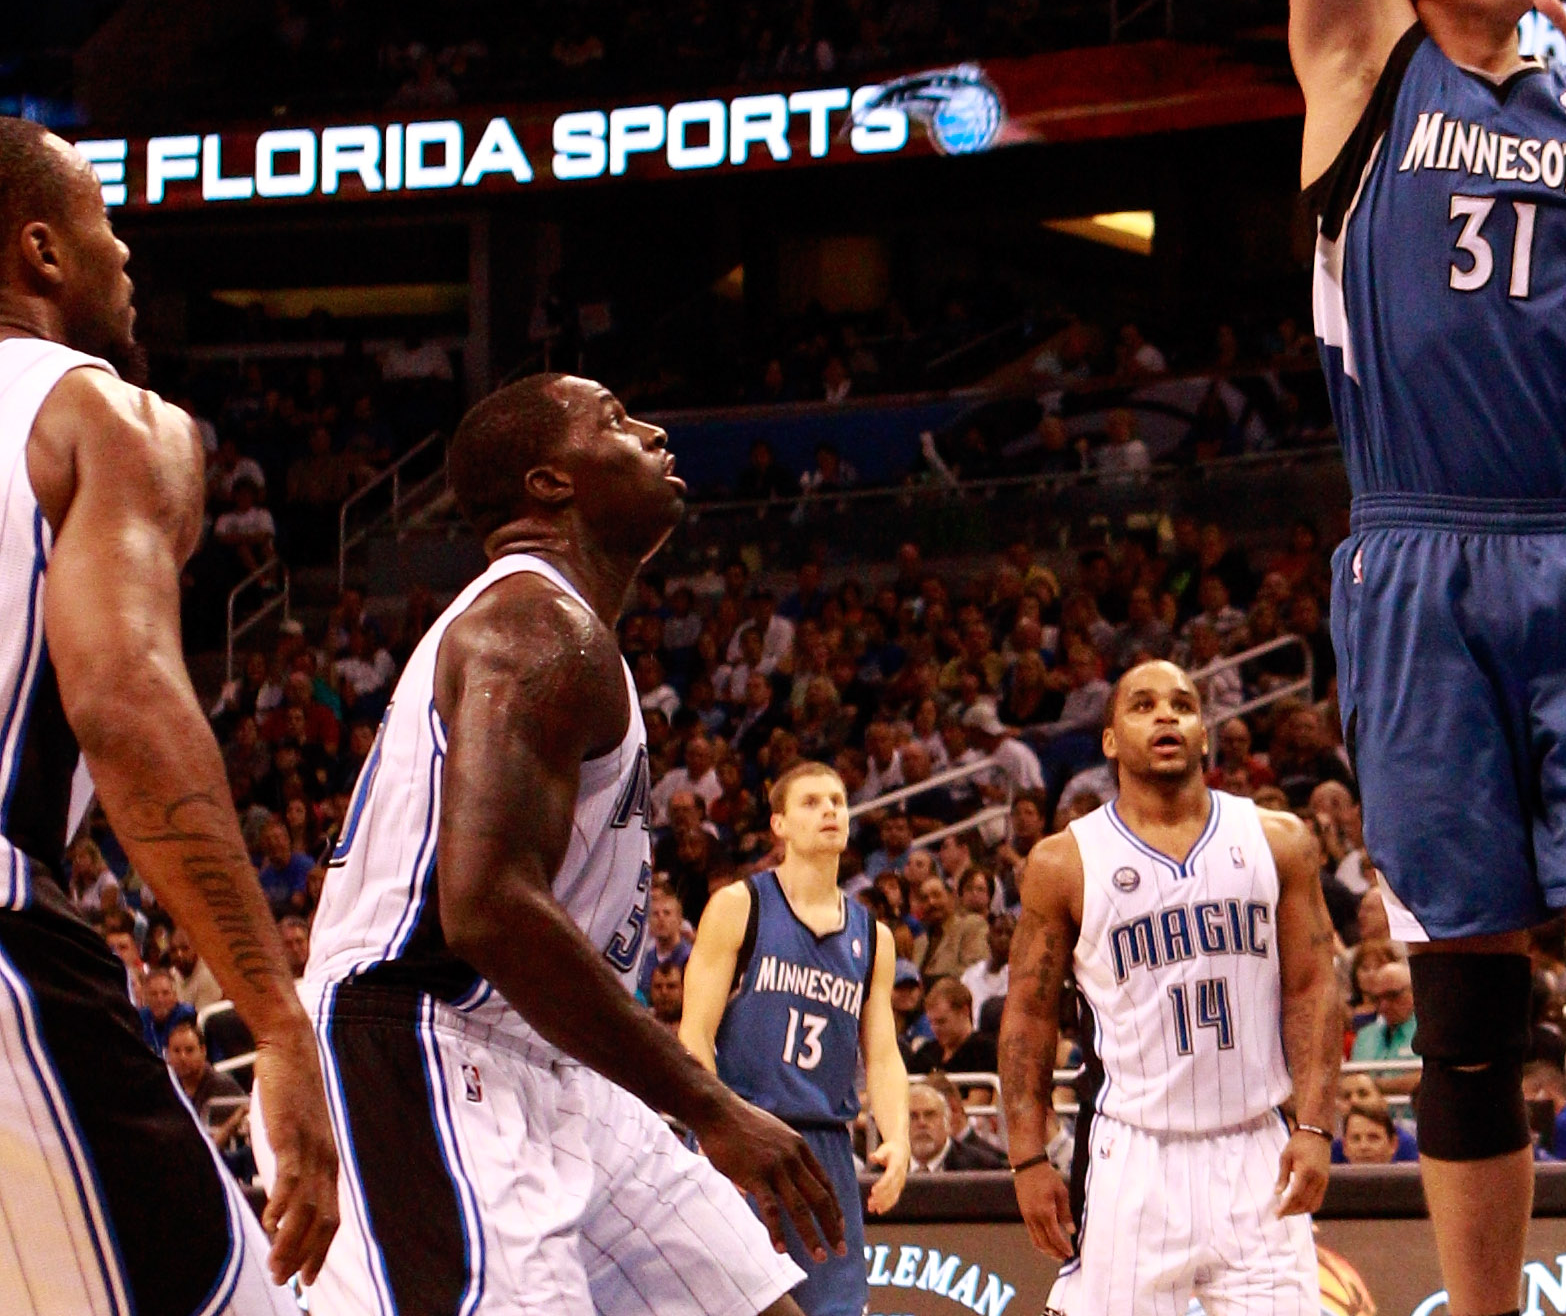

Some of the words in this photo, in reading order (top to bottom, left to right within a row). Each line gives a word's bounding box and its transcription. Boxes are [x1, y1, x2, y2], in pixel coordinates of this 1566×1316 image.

[145, 117, 534, 205] FLORIDA
[552, 84, 909, 181] SPORTS
[1449, 194, 1538, 299] 31
[1108, 898, 1270, 985] MAGIC
[754, 955, 864, 1021] MINNESOTA
[1167, 976, 1235, 1057] 14
[782, 1006, 828, 1071] 13
